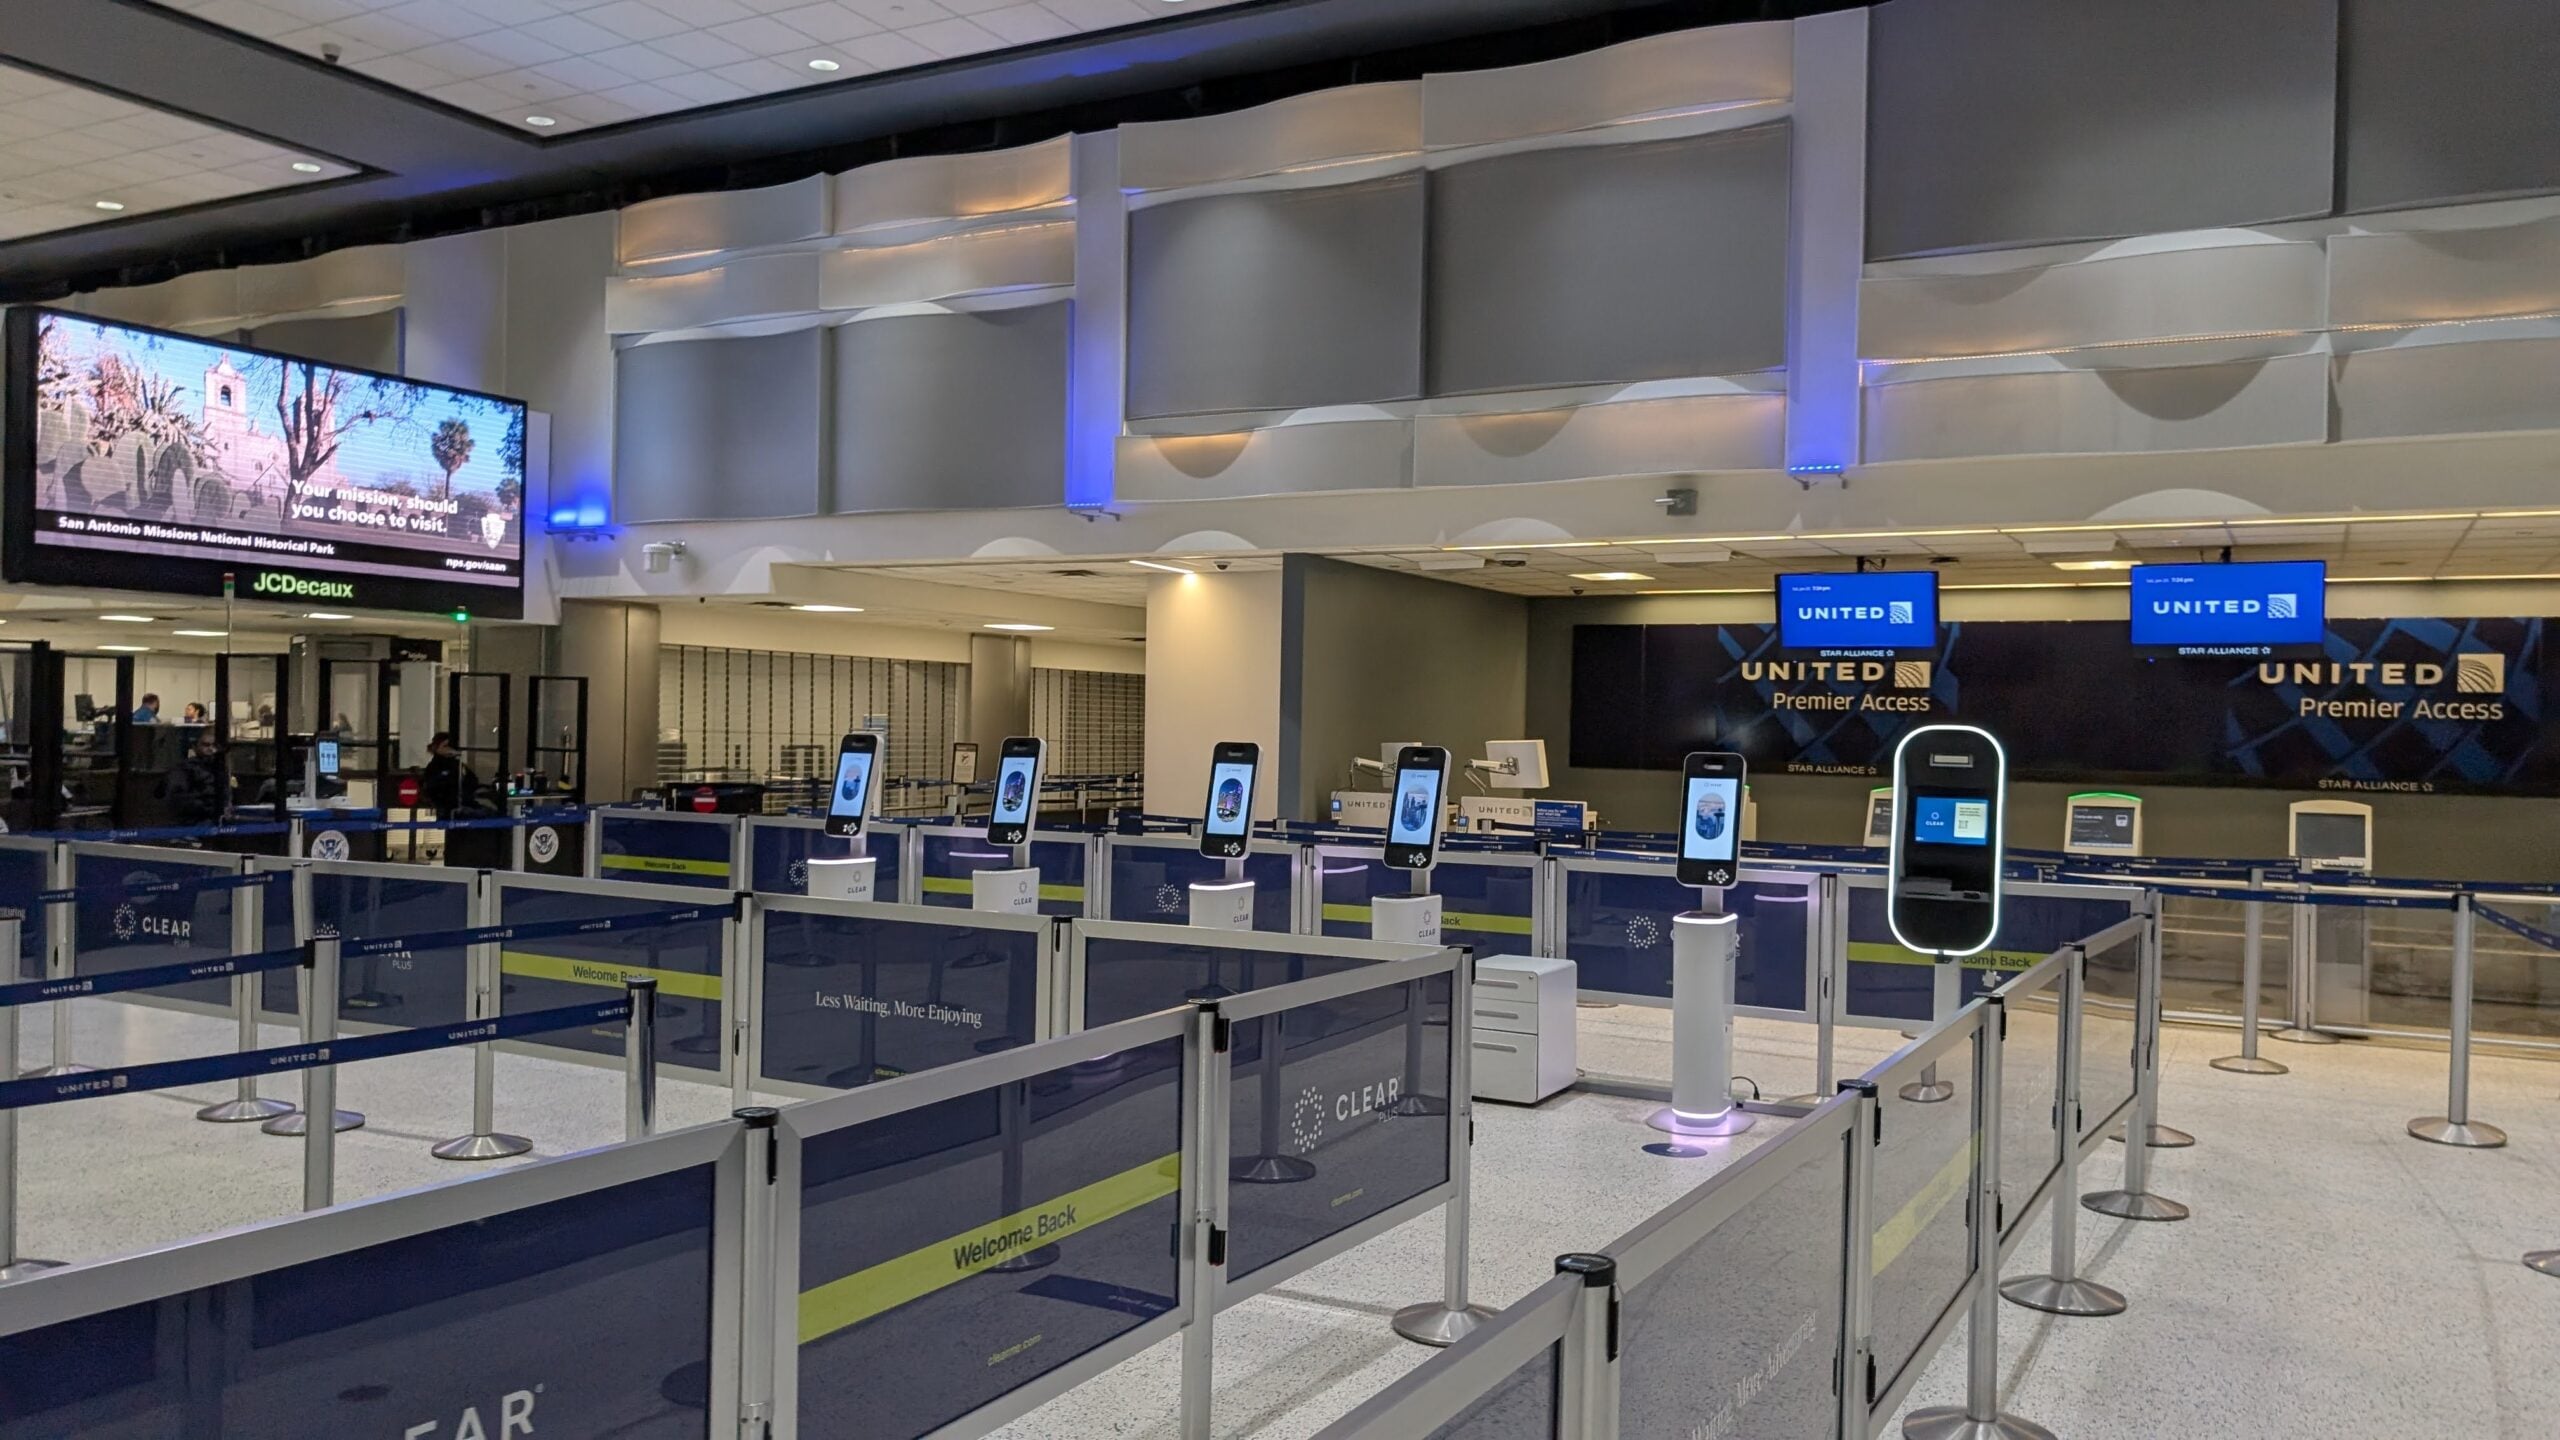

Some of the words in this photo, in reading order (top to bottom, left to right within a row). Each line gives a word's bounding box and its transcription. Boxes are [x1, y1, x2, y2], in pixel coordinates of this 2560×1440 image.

[292, 480, 332, 498] Your
[336, 487, 402, 509] mission,
[407, 495, 458, 514] should
[291, 503, 324, 519] you
[328, 506, 386, 526] choose
[389, 513, 406, 528] to
[410, 517, 447, 533] visit.
[59, 516, 84, 530] San
[87, 519, 141, 536] Antonio
[143, 525, 198, 541] Missions
[201, 530, 252, 547] National
[254, 536, 308, 552] Historical
[310, 542, 335, 555] Park
[446, 557, 506, 572] nps.gov/saan
[254, 572, 353, 598] JCDecaux
[1798, 606, 1884, 619] UNITED
[2153, 600, 2261, 614] UNITED
[2178, 647, 2205, 655] STAR
[2207, 647, 2259, 655] ALLIANCE
[1741, 661, 1885, 681] UNITED
[2259, 663, 2444, 685] UNITED
[1773, 692, 1854, 710] Premier
[1860, 693, 1930, 711] Access
[2300, 698, 2404, 718] Premier
[2412, 699, 2504, 719] Access
[1788, 764, 1813, 773] STAR
[1816, 765, 1865, 774] ALLIANCE
[2318, 779, 2350, 789] STAR
[2354, 781, 2418, 792] ALLIANCE
[1347, 801, 1386, 809] UNITED
[1478, 806, 1520, 815] UNITED
[847, 886, 867, 894] CLEAR
[1014, 897, 1032, 906] CLEAR
[1233, 914, 1249, 923] CLEAR
[1441, 915, 1461, 926] ack
[142, 917, 190, 937] CLEAR
[1418, 928, 1436, 938] CLEAR
[364, 942, 393, 951] UNITED
[392, 960, 412, 970] PLUS
[2000, 955, 2031, 967] Back
[191, 965, 226, 975] UNITED
[573, 965, 618, 983] Welcome
[42, 984, 82, 995] UNITED
[816, 991, 841, 1009] Less
[843, 994, 891, 1018] Waiting,
[894, 1001, 925, 1018] More
[928, 1004, 983, 1029] Enjoying
[448, 1027, 485, 1040] UNITED
[270, 1052, 316, 1066] UNITED
[57, 1080, 111, 1095] UNITED
[1336, 1078, 1399, 1121] CLEAR
[1379, 1106, 1399, 1123] PLUS
[953, 1225, 1033, 1270] Welcome
[1037, 1204, 1077, 1238] Back
